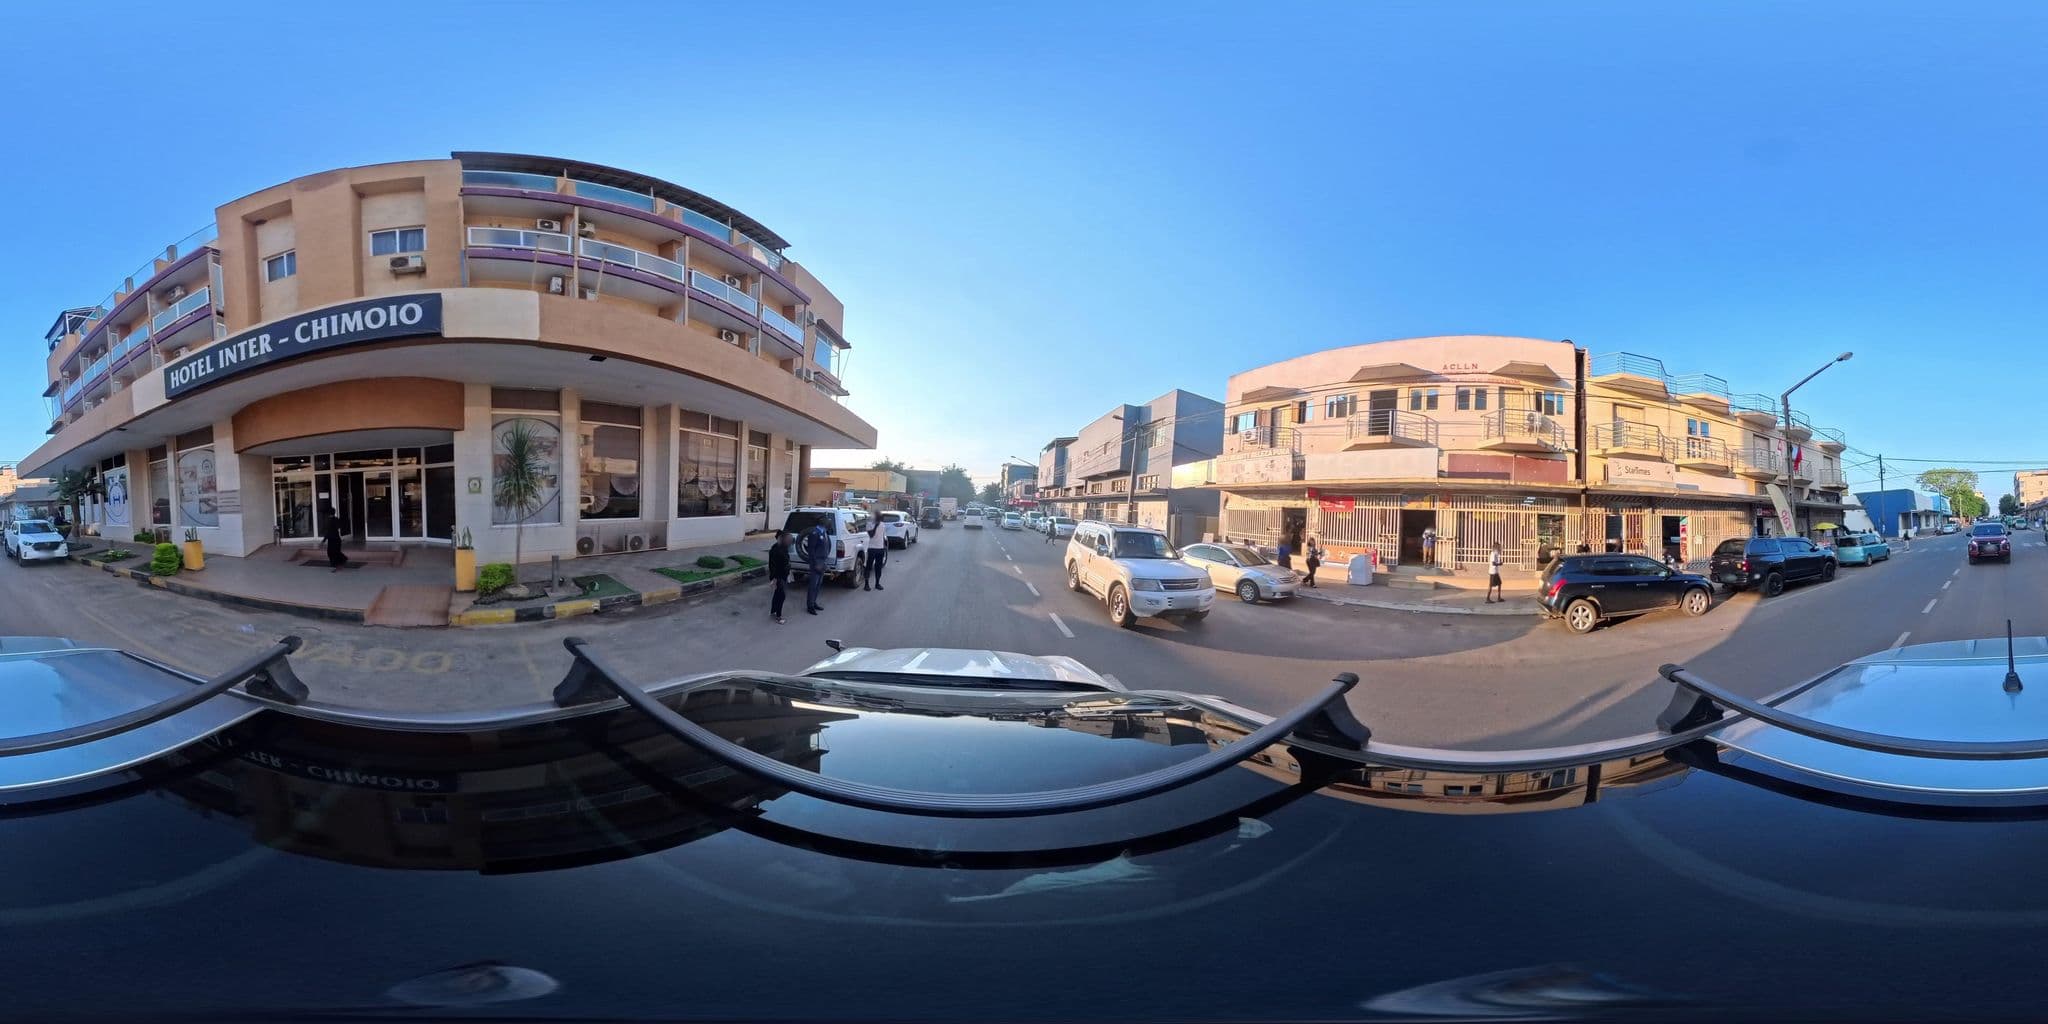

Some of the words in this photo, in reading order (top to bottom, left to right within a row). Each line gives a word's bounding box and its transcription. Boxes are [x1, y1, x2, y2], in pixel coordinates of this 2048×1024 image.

[170, 362, 214, 389] HOTEL
[219, 333, 273, 369] INTER
[294, 302, 424, 343] CHIMOIO
[1624, 465, 1651, 476] StarTimes
